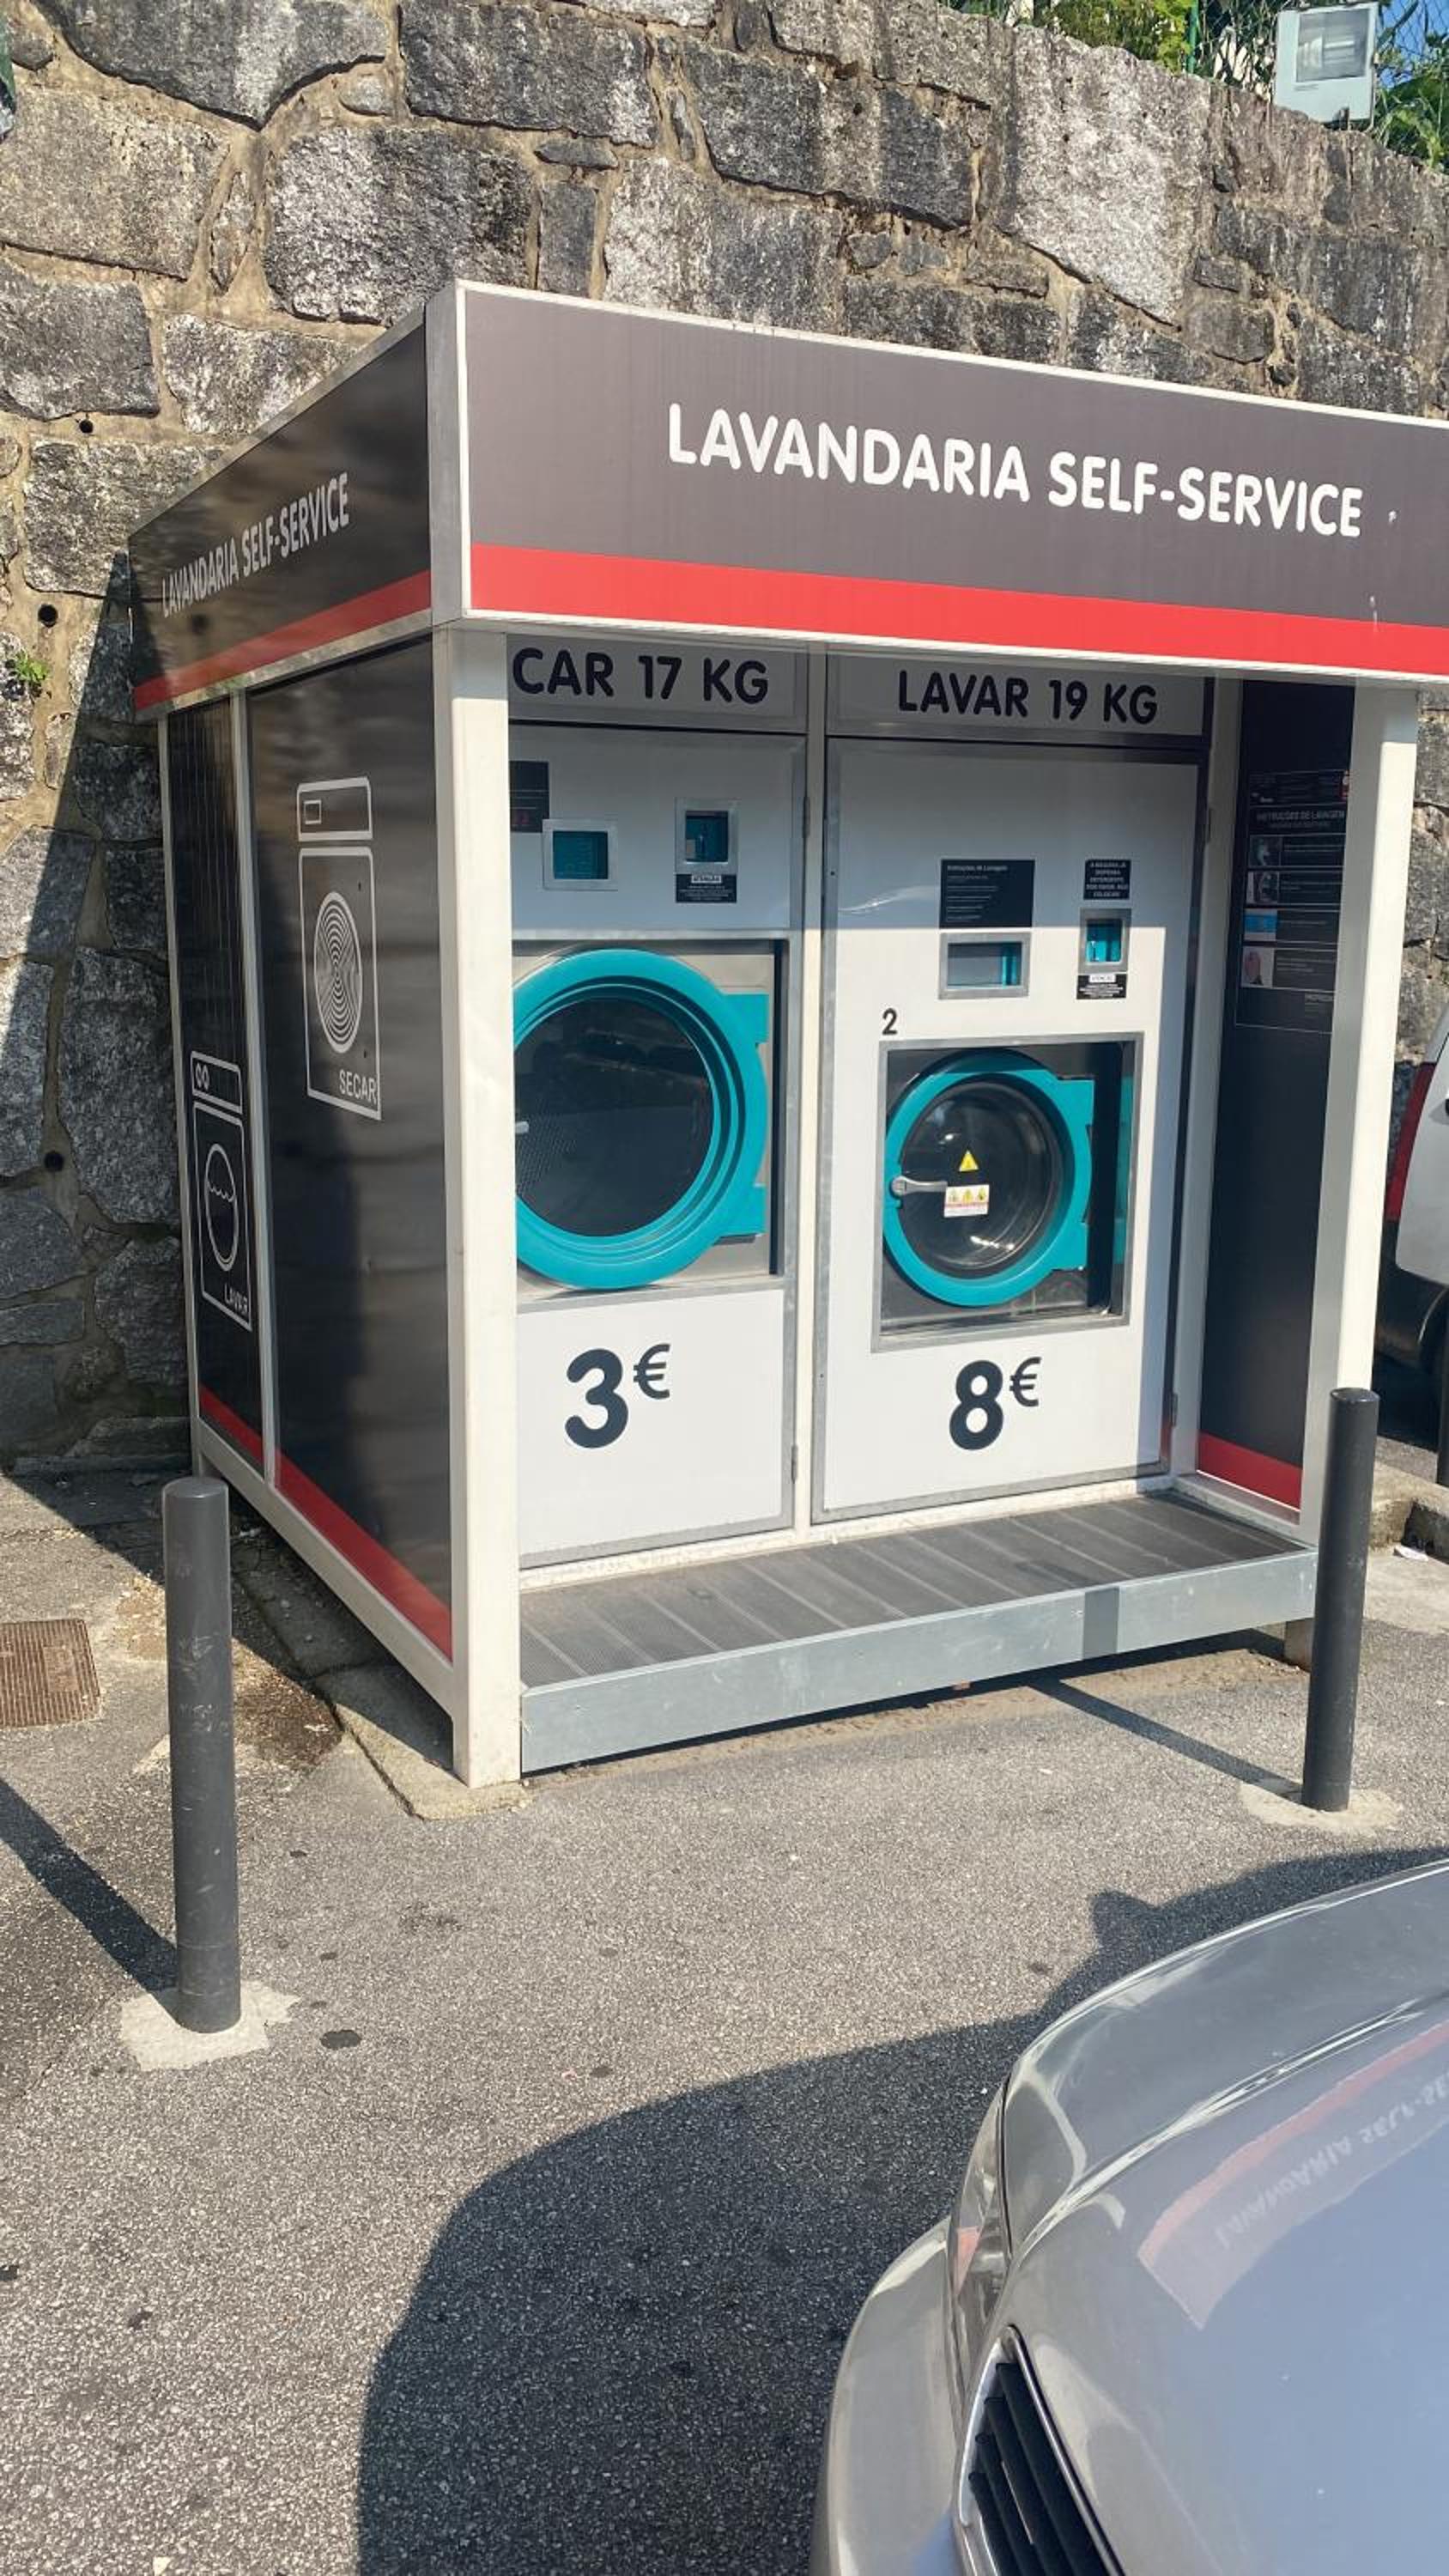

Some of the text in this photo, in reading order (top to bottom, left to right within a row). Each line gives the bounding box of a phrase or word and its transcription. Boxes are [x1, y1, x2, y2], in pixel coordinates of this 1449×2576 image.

[669, 402, 1363, 538] LAVANDARIA SELF-SERVICE
[161, 471, 349, 618] LAVANDARIA SELF-SERVICE
[638, 654, 682, 700] 17
[703, 657, 769, 705] KG
[898, 669, 1158, 725] LAVAR 19 KG
[882, 1007, 898, 1036] 2
[339, 1068, 377, 1106] SECAR
[224, 1282, 248, 1315] LAVAR
